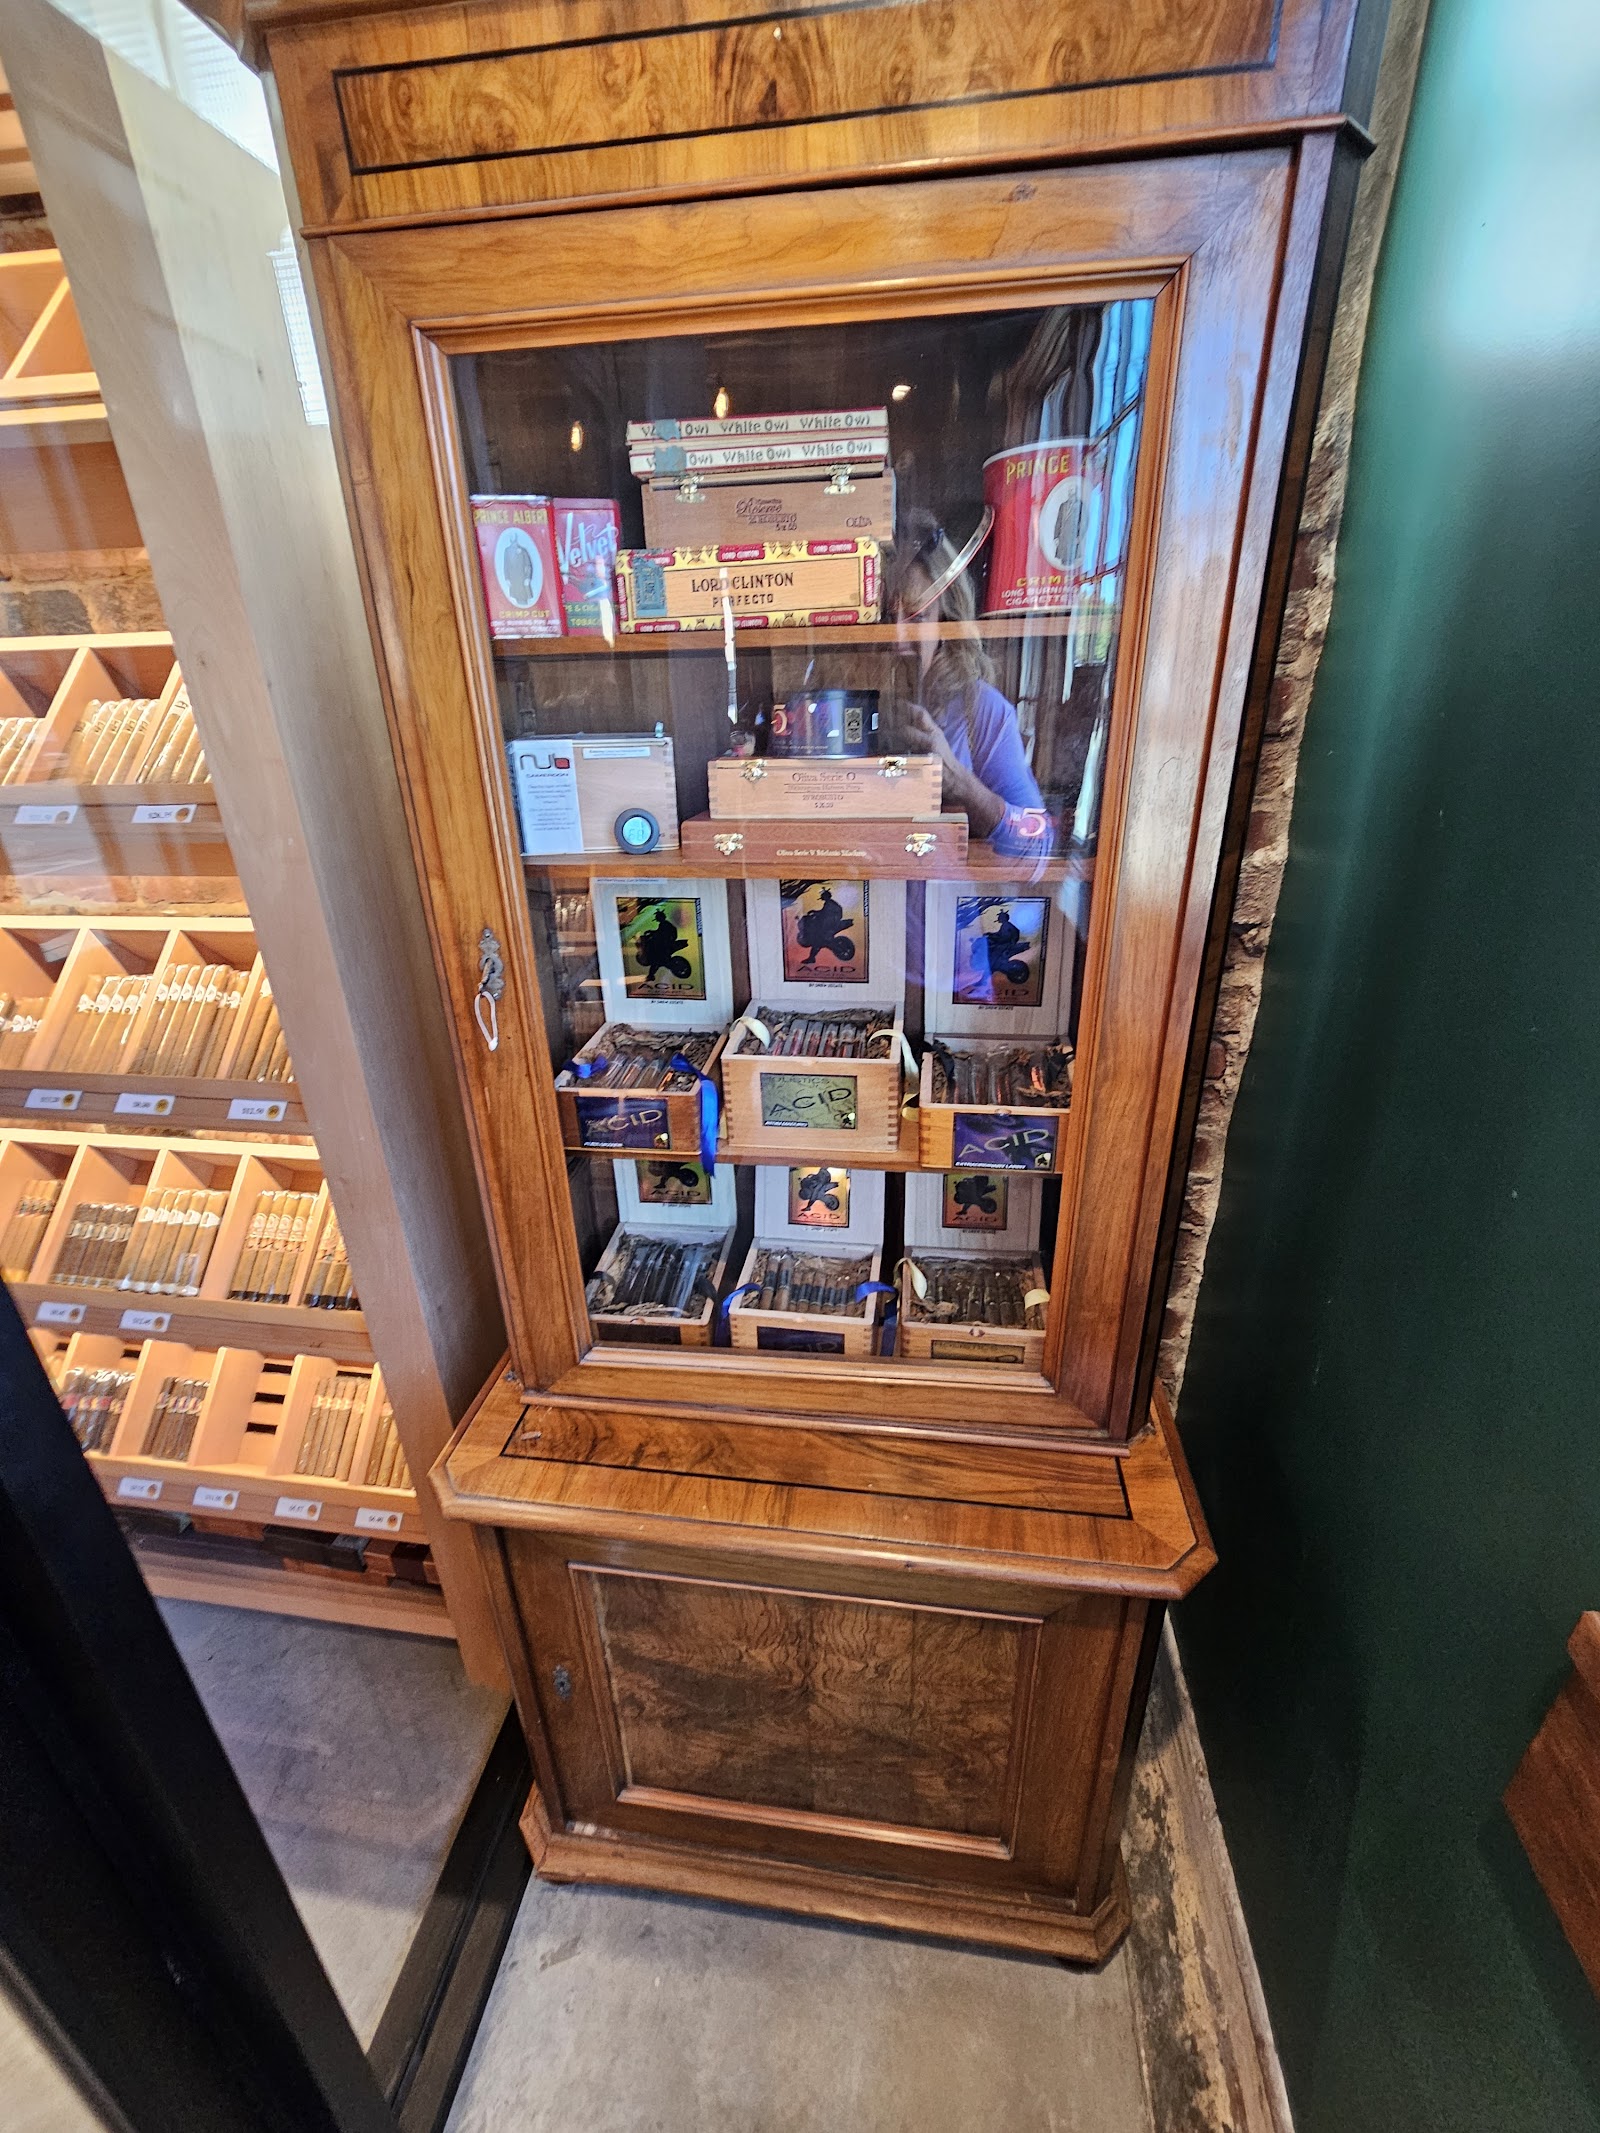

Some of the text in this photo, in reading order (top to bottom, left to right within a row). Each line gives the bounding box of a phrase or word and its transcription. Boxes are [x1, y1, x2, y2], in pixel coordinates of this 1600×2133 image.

[686, 414, 870, 435] Owl White Owl White Owl
[688, 441, 872, 466] Owl White Owl White Owl
[1006, 454, 1070, 485] PRINCE
[474, 509, 548, 526] PRINCE ALBERT
[557, 512, 619, 574] Velvet
[692, 572, 794, 592] LORD CLINTON
[1002, 589, 1024, 598] LONG
[498, 610, 552, 618] CRIMP CUT
[792, 772, 818, 782] Oliva
[846, 772, 856, 781] O
[1019, 807, 1047, 837] 5
[769, 1088, 852, 1116] ACID
[586, 1110, 663, 1136] ACID
[958, 1128, 1050, 1158] ACID
[798, 1212, 840, 1220] ACID
